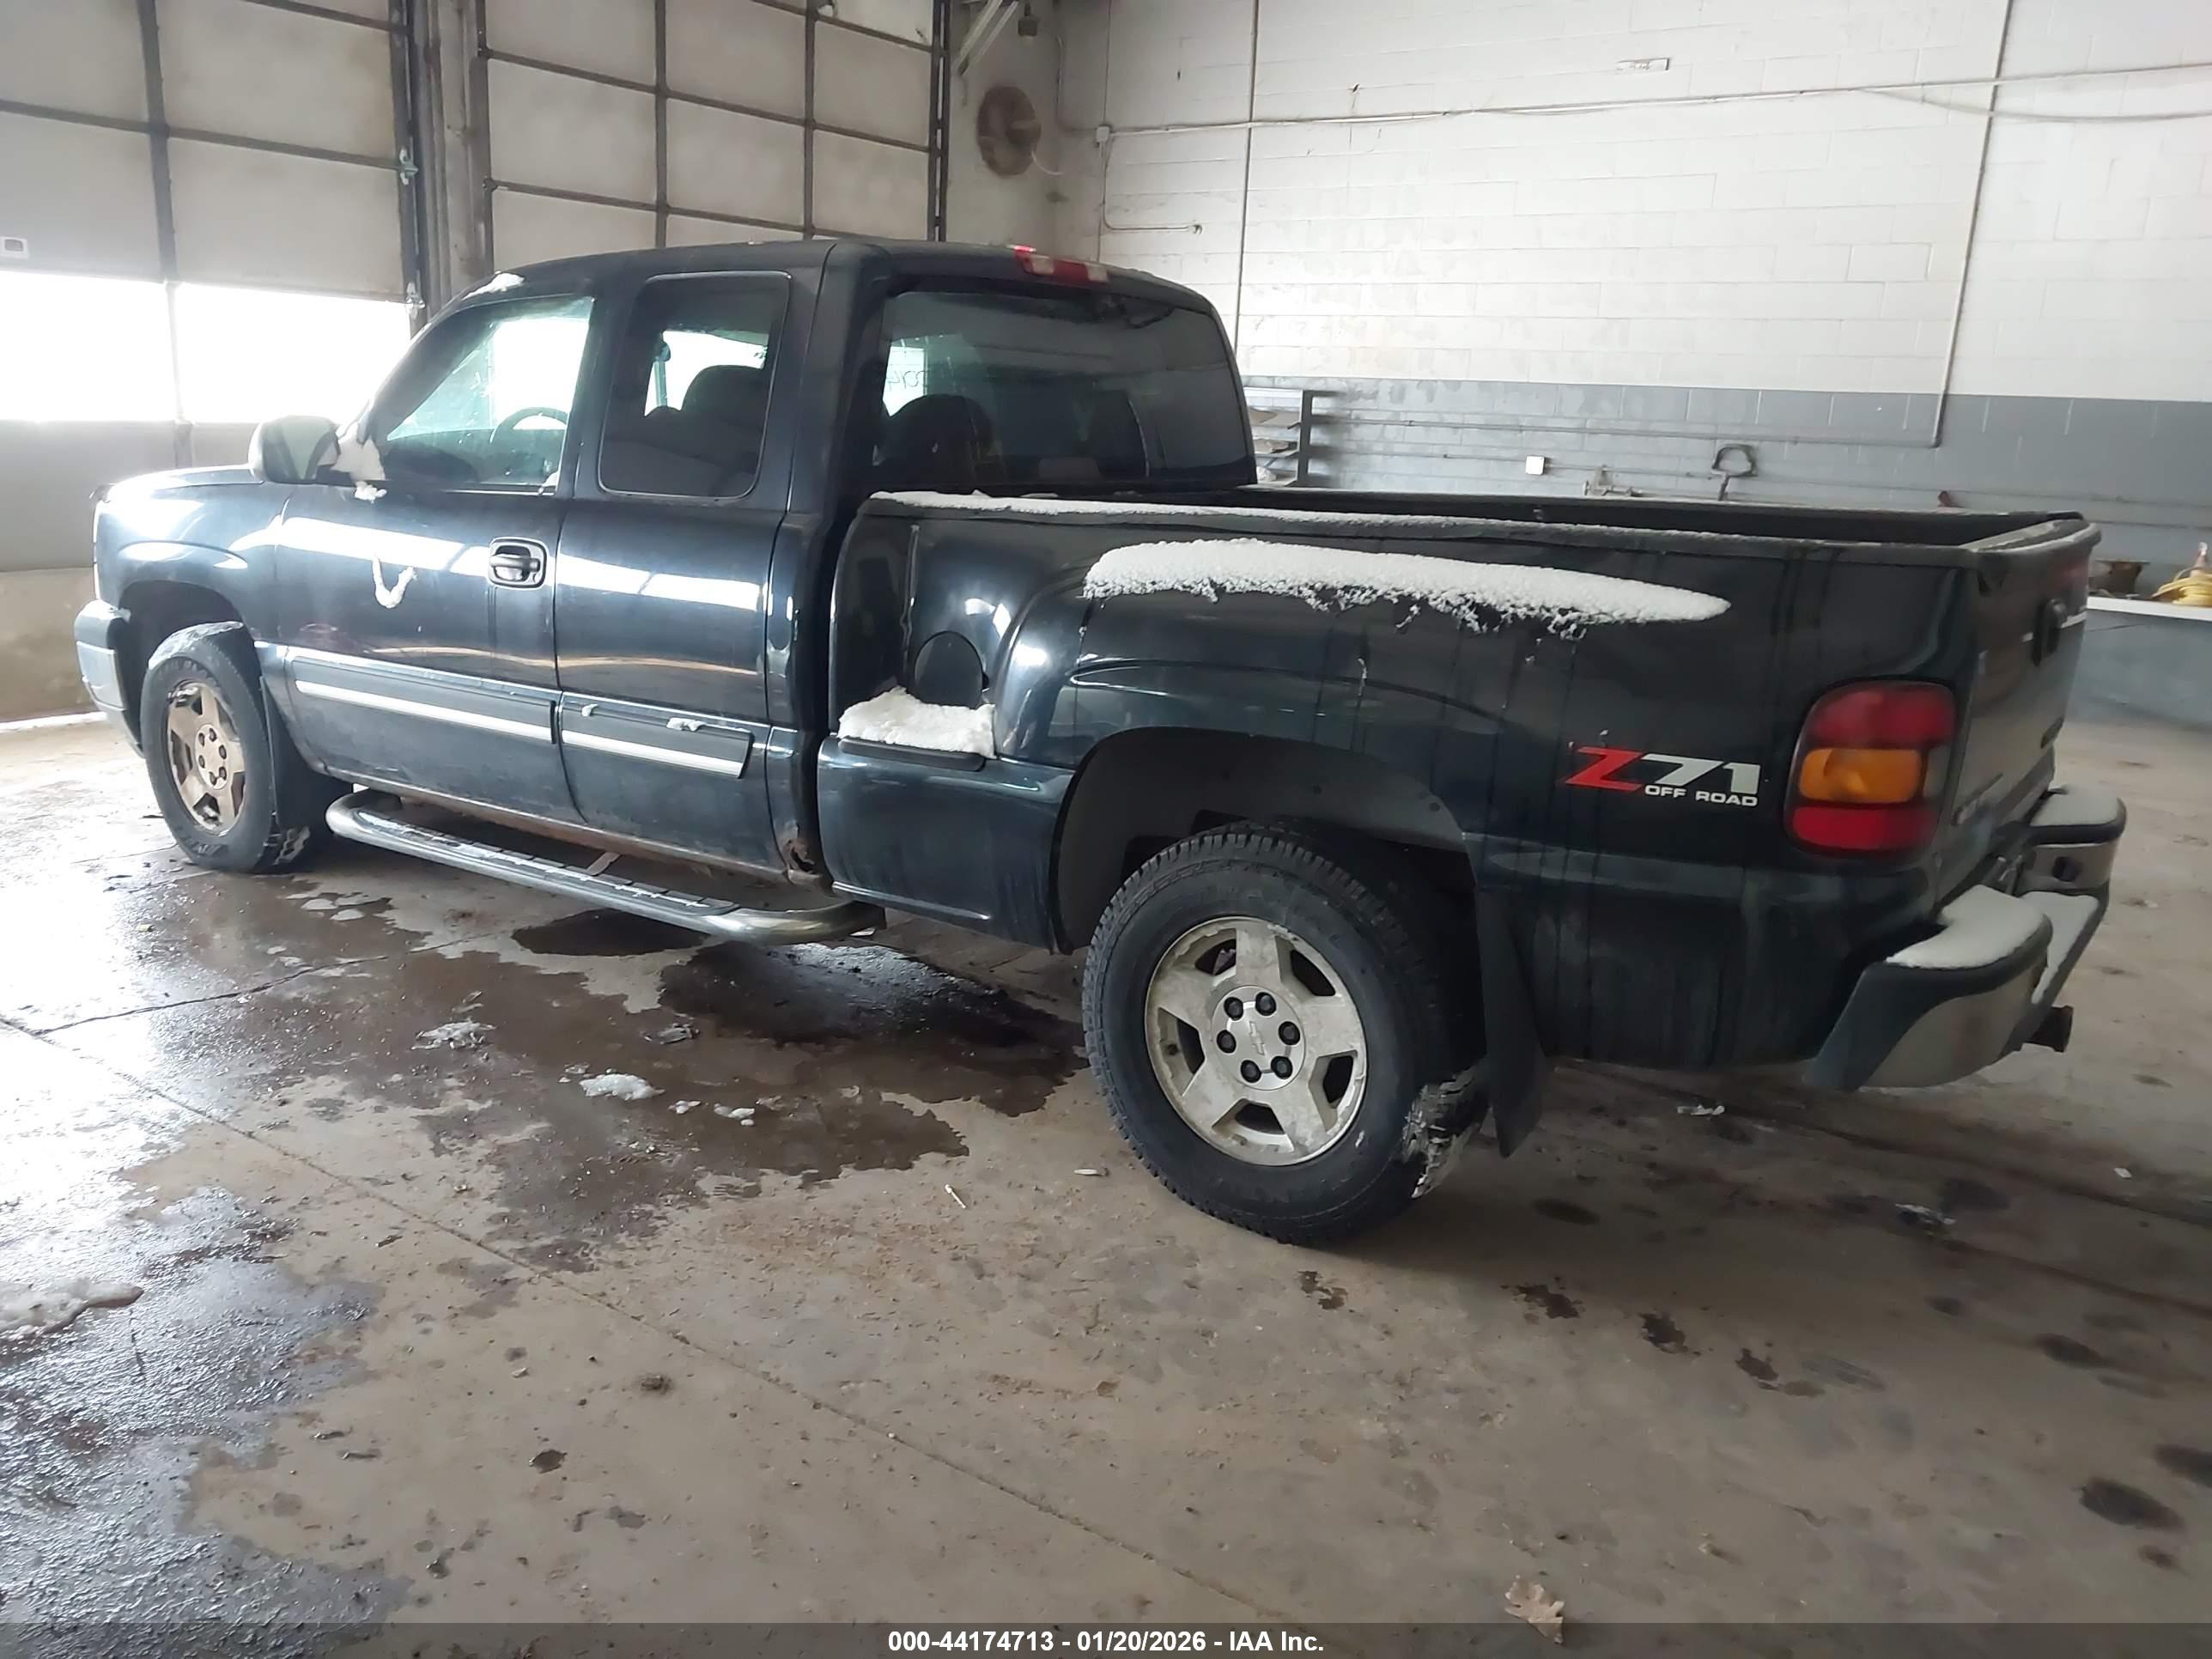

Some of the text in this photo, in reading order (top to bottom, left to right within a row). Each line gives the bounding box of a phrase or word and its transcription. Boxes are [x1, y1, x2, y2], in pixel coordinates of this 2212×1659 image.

[1565, 746, 1760, 795] Z71
[1644, 785, 1759, 807] OFF ROAD
